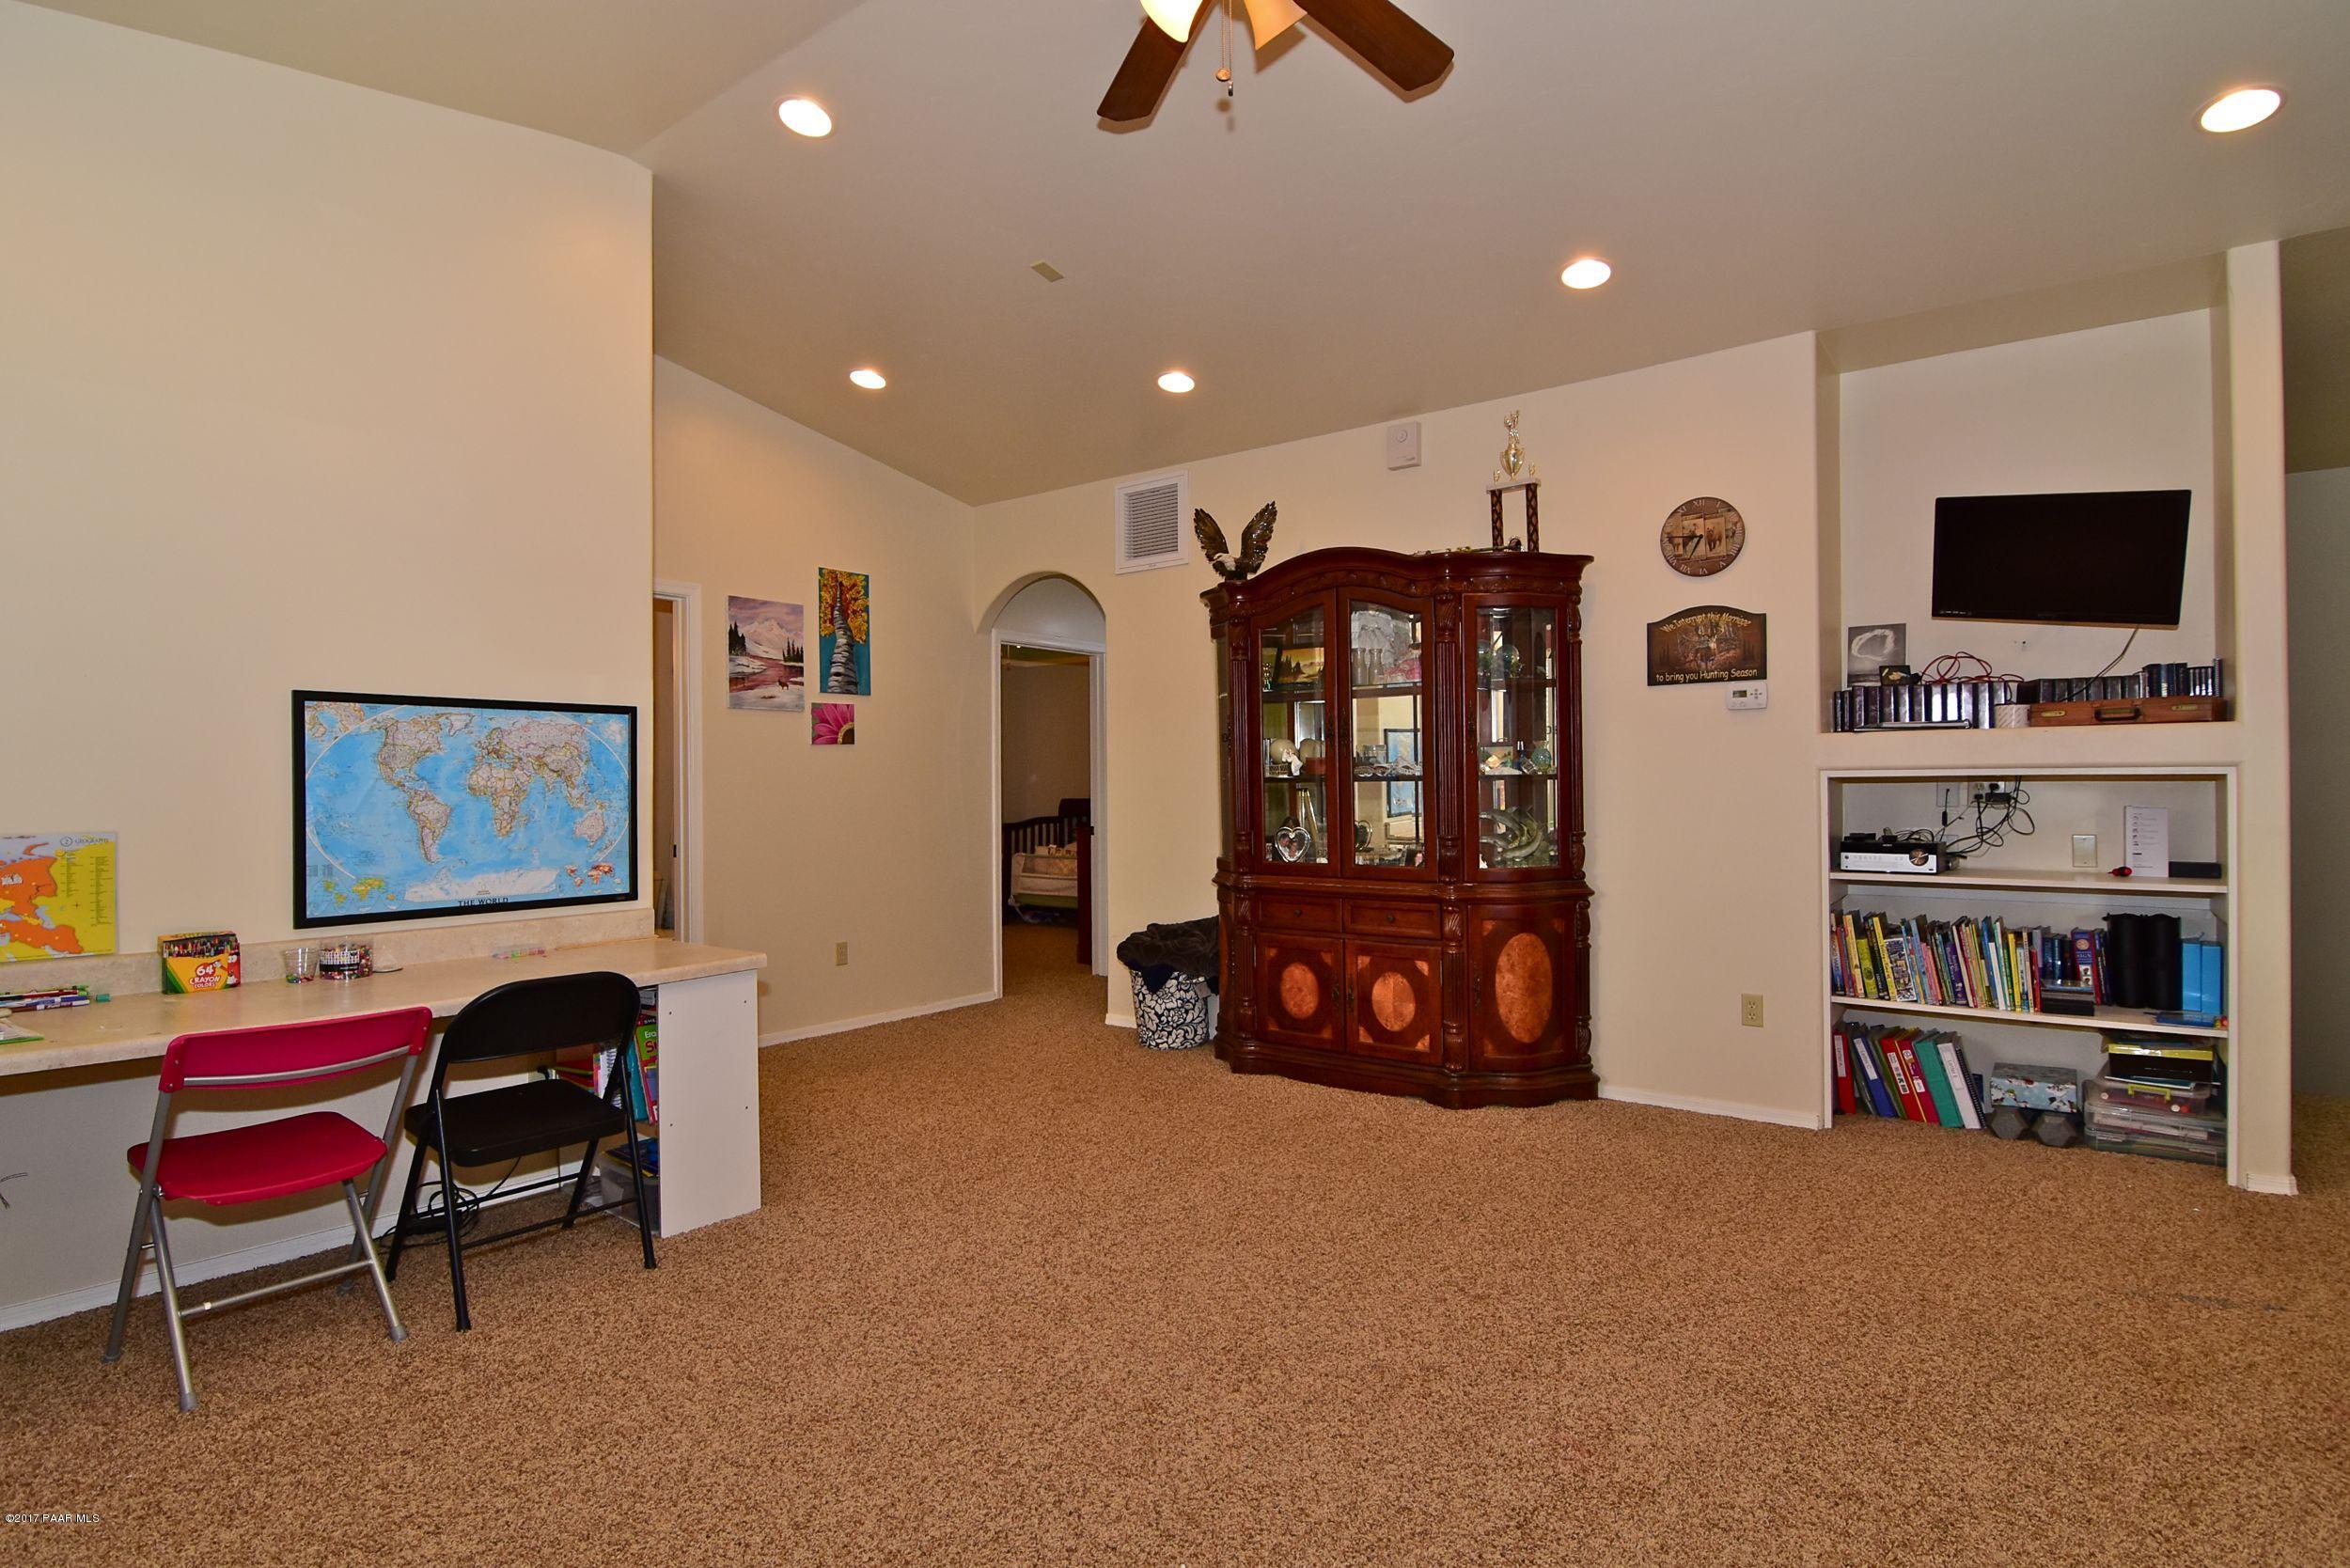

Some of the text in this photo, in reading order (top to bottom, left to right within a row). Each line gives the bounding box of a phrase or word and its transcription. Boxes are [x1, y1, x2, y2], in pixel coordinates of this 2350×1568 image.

[1659, 623, 1676, 633] We
[1673, 613, 1705, 628] Interrupt
[1707, 612, 1720, 622] this
[1656, 668, 1758, 683] to bring you Hunting Season
[196, 965, 214, 976] 64
[189, 976, 221, 985] CRAYON
